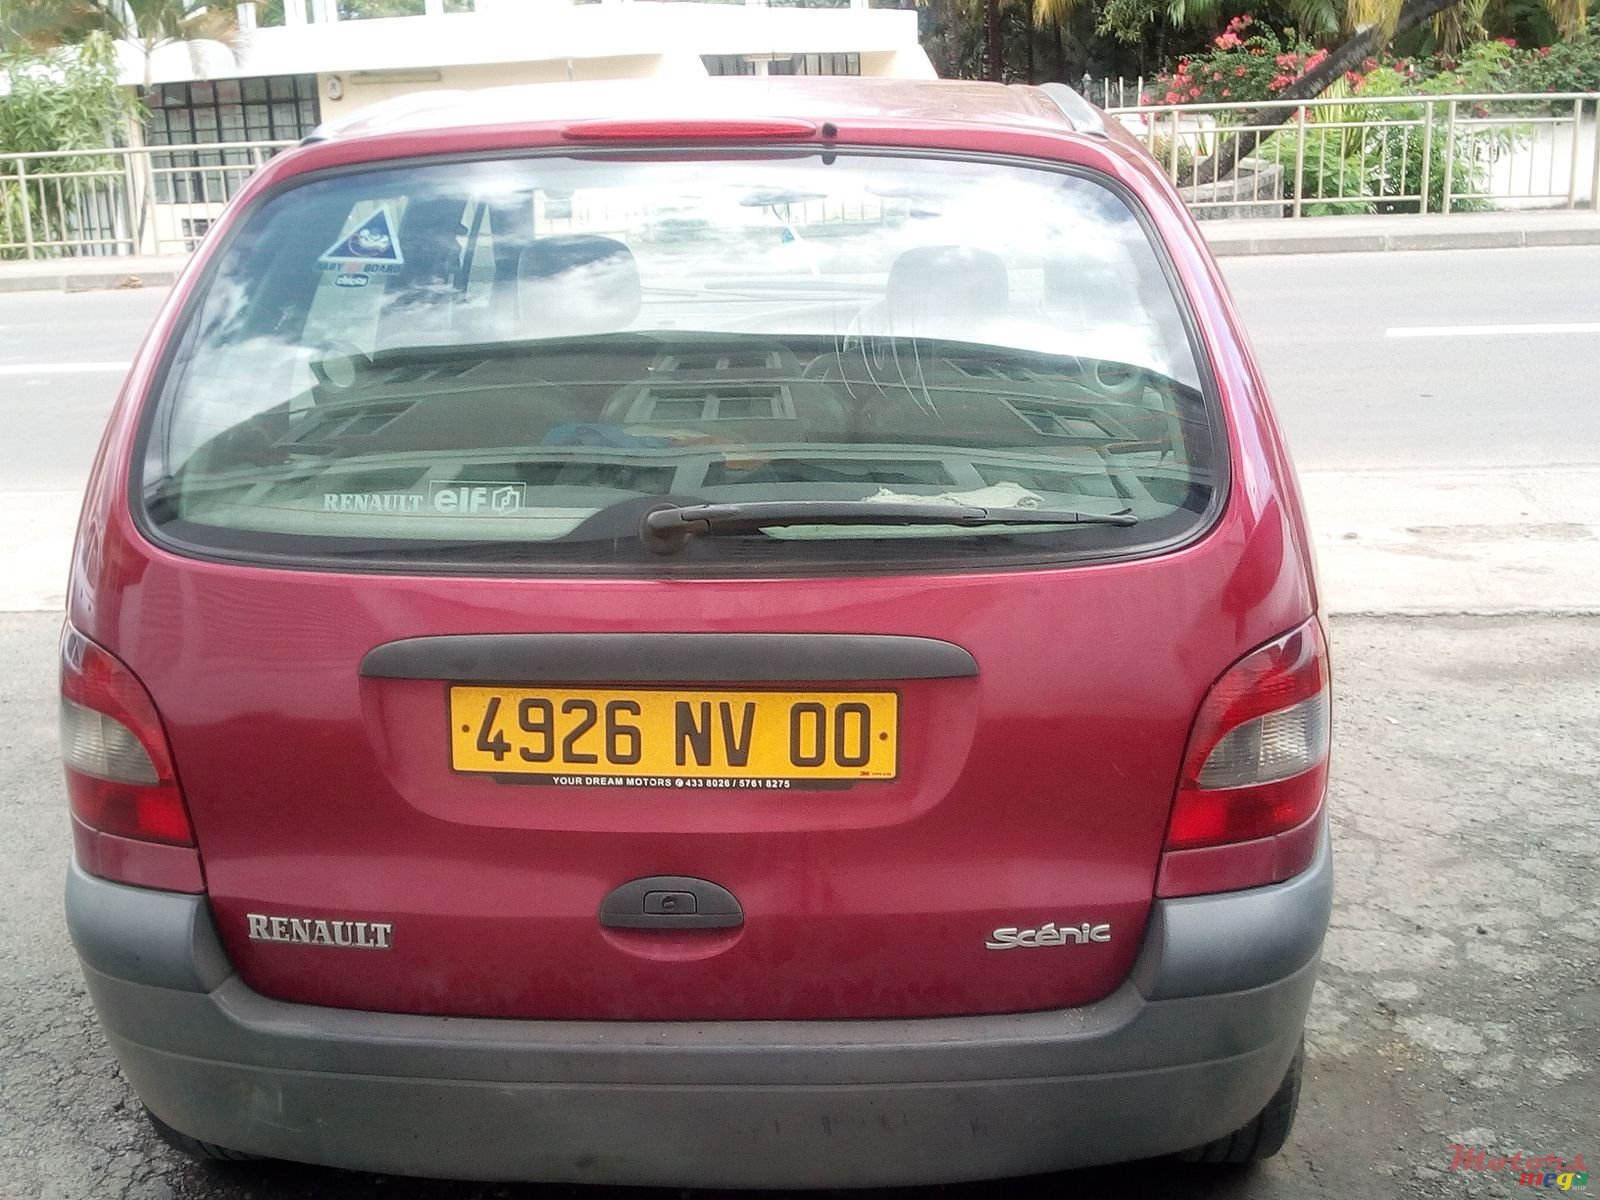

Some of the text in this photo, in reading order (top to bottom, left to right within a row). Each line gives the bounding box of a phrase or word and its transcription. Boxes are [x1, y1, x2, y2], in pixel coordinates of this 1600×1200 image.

[323, 487, 486, 513] RENAULT elf
[476, 697, 870, 768] 4926 NV 00
[553, 776, 583, 785] YOUR
[585, 777, 624, 786] DREAM
[626, 778, 672, 787] MOTORS
[685, 779, 703, 788] 433
[706, 779, 730, 788] 8026
[739, 780, 762, 788] 5761
[765, 780, 790, 789] 8275
[246, 913, 392, 949] RENAULT
[985, 922, 1111, 950] Scénic
